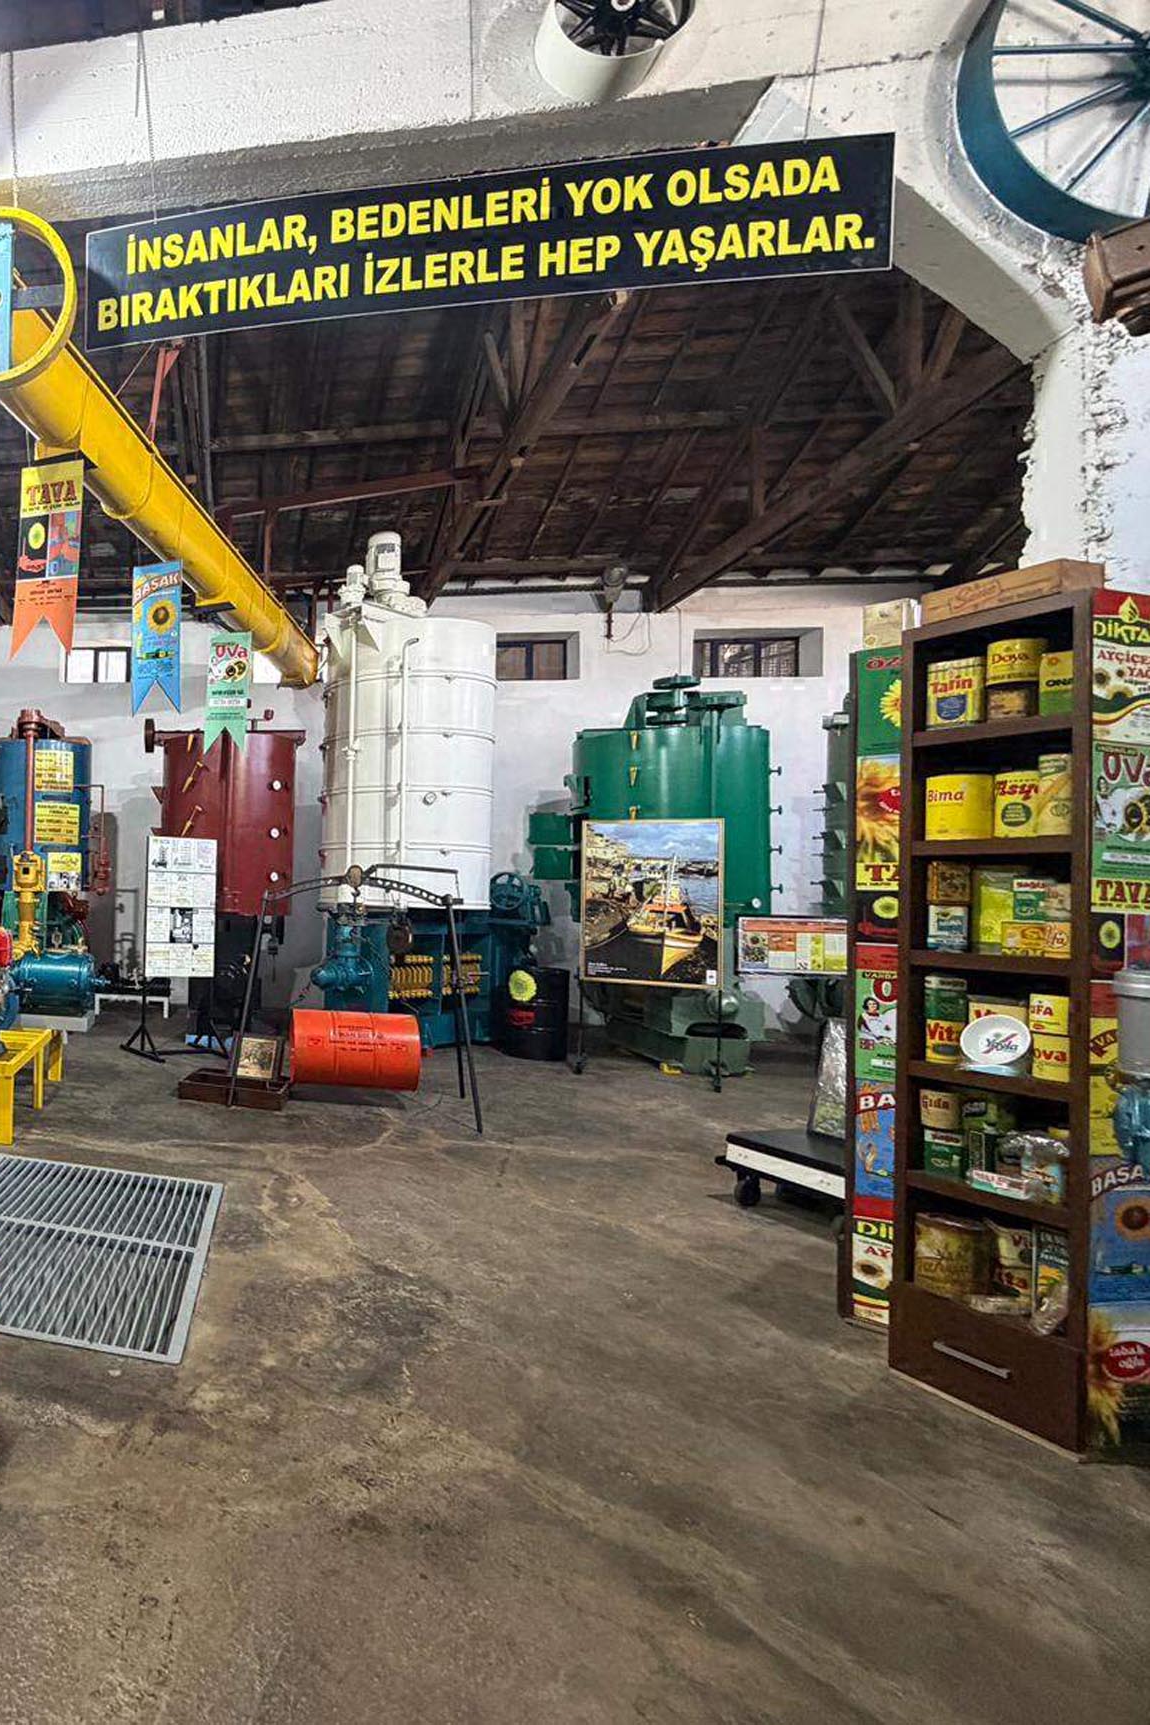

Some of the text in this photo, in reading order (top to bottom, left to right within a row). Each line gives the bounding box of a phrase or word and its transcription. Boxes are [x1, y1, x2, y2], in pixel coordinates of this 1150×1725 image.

[97, 213, 876, 332] BIRAKTIKLARI İZLERLE HEP YAŞARLAR.
[126, 155, 841, 275] İNSANLAR, BEDENLERİ YOK OLSADA
[26, 479, 78, 507] TAVA
